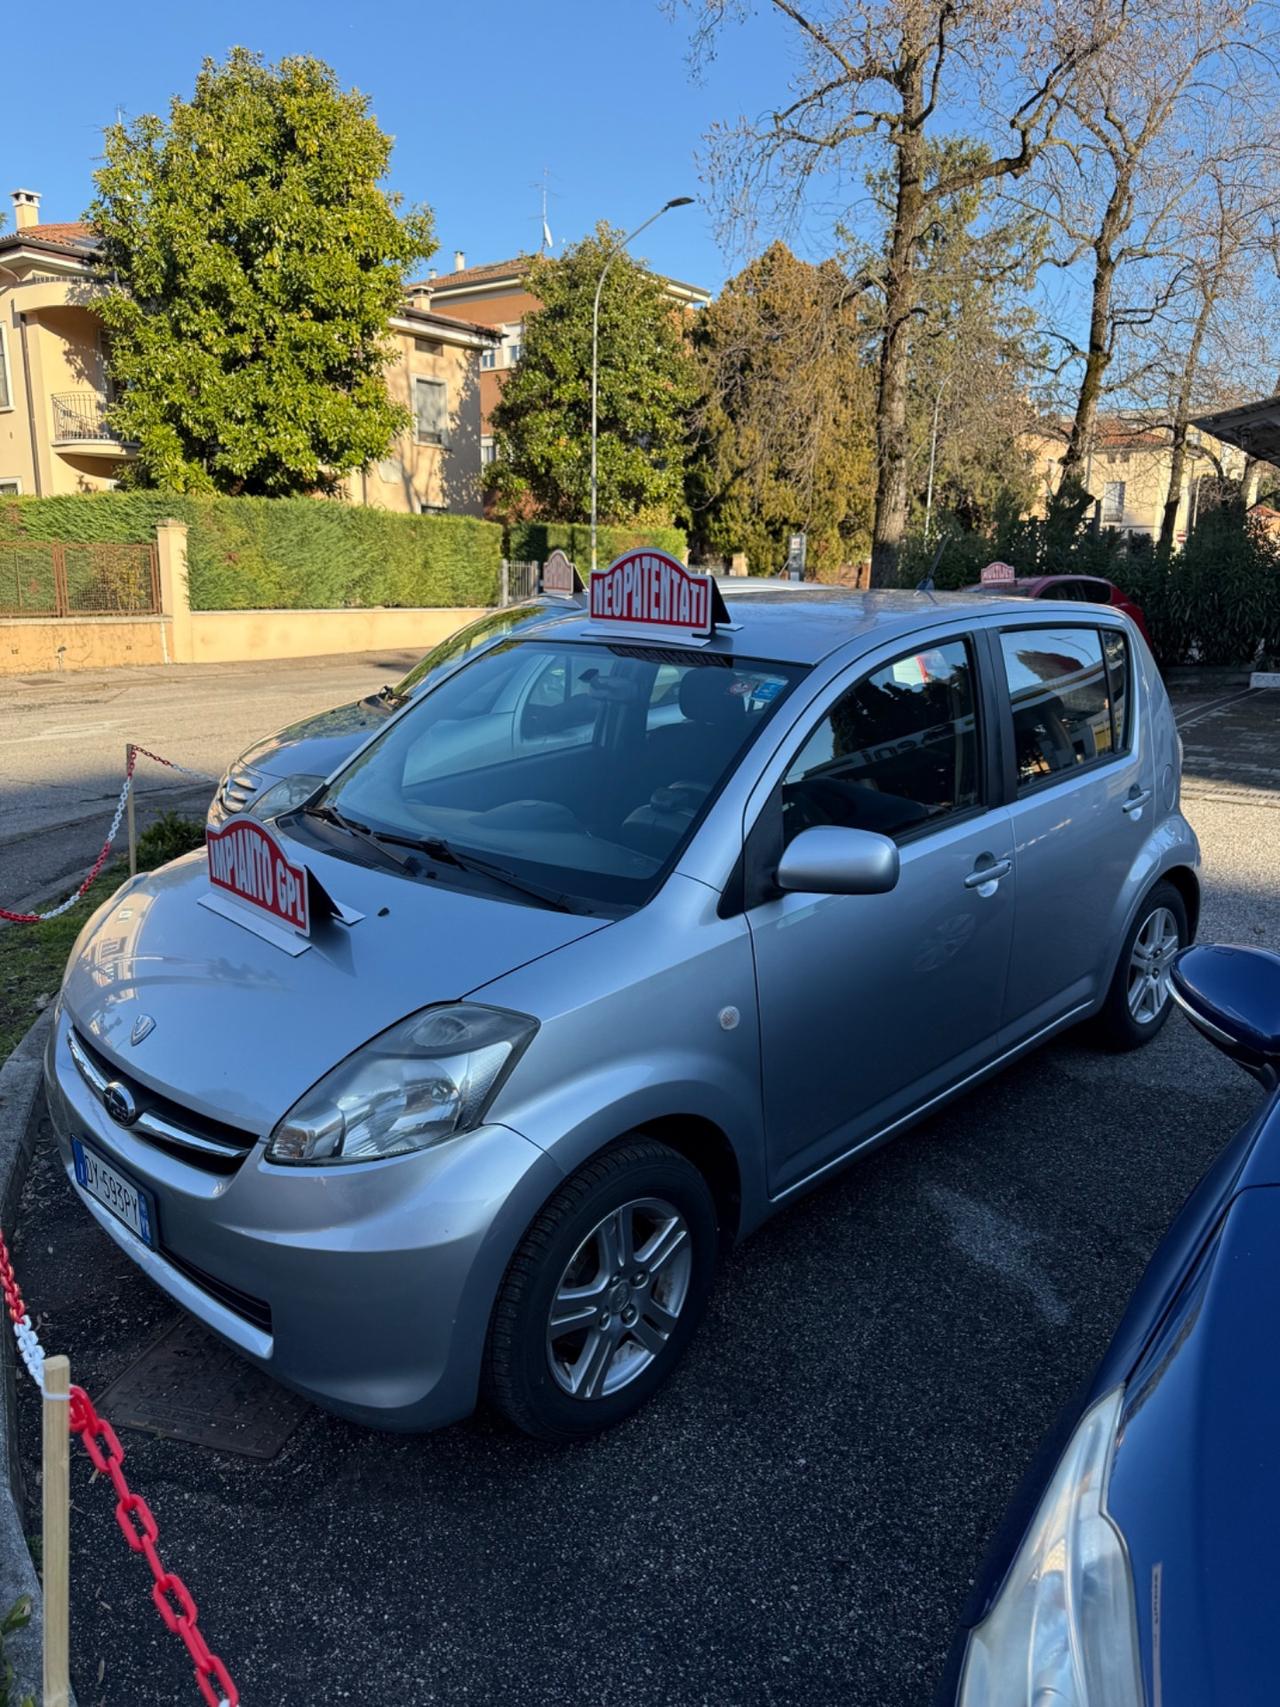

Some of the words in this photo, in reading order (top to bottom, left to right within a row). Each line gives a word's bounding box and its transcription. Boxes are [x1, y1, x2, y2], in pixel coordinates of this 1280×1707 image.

[594, 556, 704, 624] NEOPATENTATI
[210, 829, 273, 906] IMPIANTO
[276, 859, 304, 922] GPL
